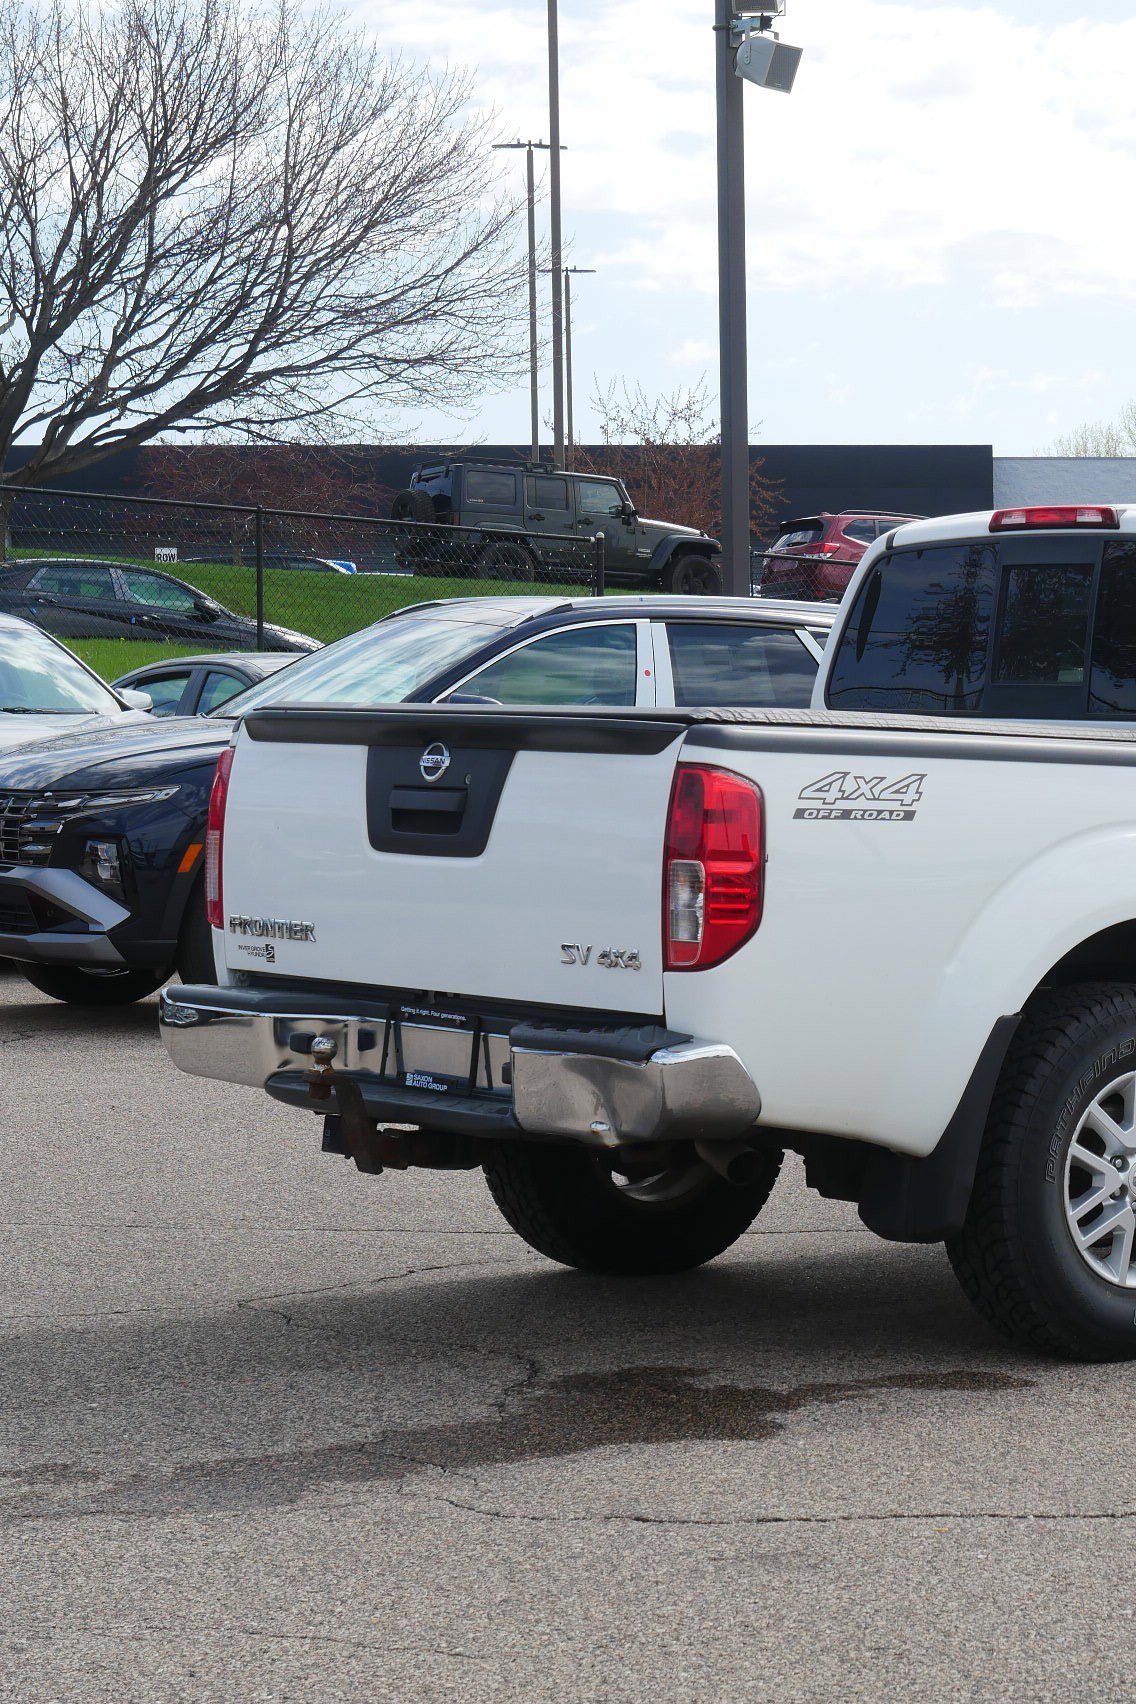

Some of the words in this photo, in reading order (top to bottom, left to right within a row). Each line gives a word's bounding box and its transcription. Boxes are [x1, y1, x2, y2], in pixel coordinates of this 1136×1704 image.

[420, 757, 446, 766] NISSAN
[803, 809, 842, 819] OFF
[850, 810, 905, 820] ROAD
[229, 914, 316, 942] FRONTIER
[561, 943, 592, 965] SV
[413, 1073, 433, 1082] SAXON
[428, 1082, 448, 1090] GROUP
